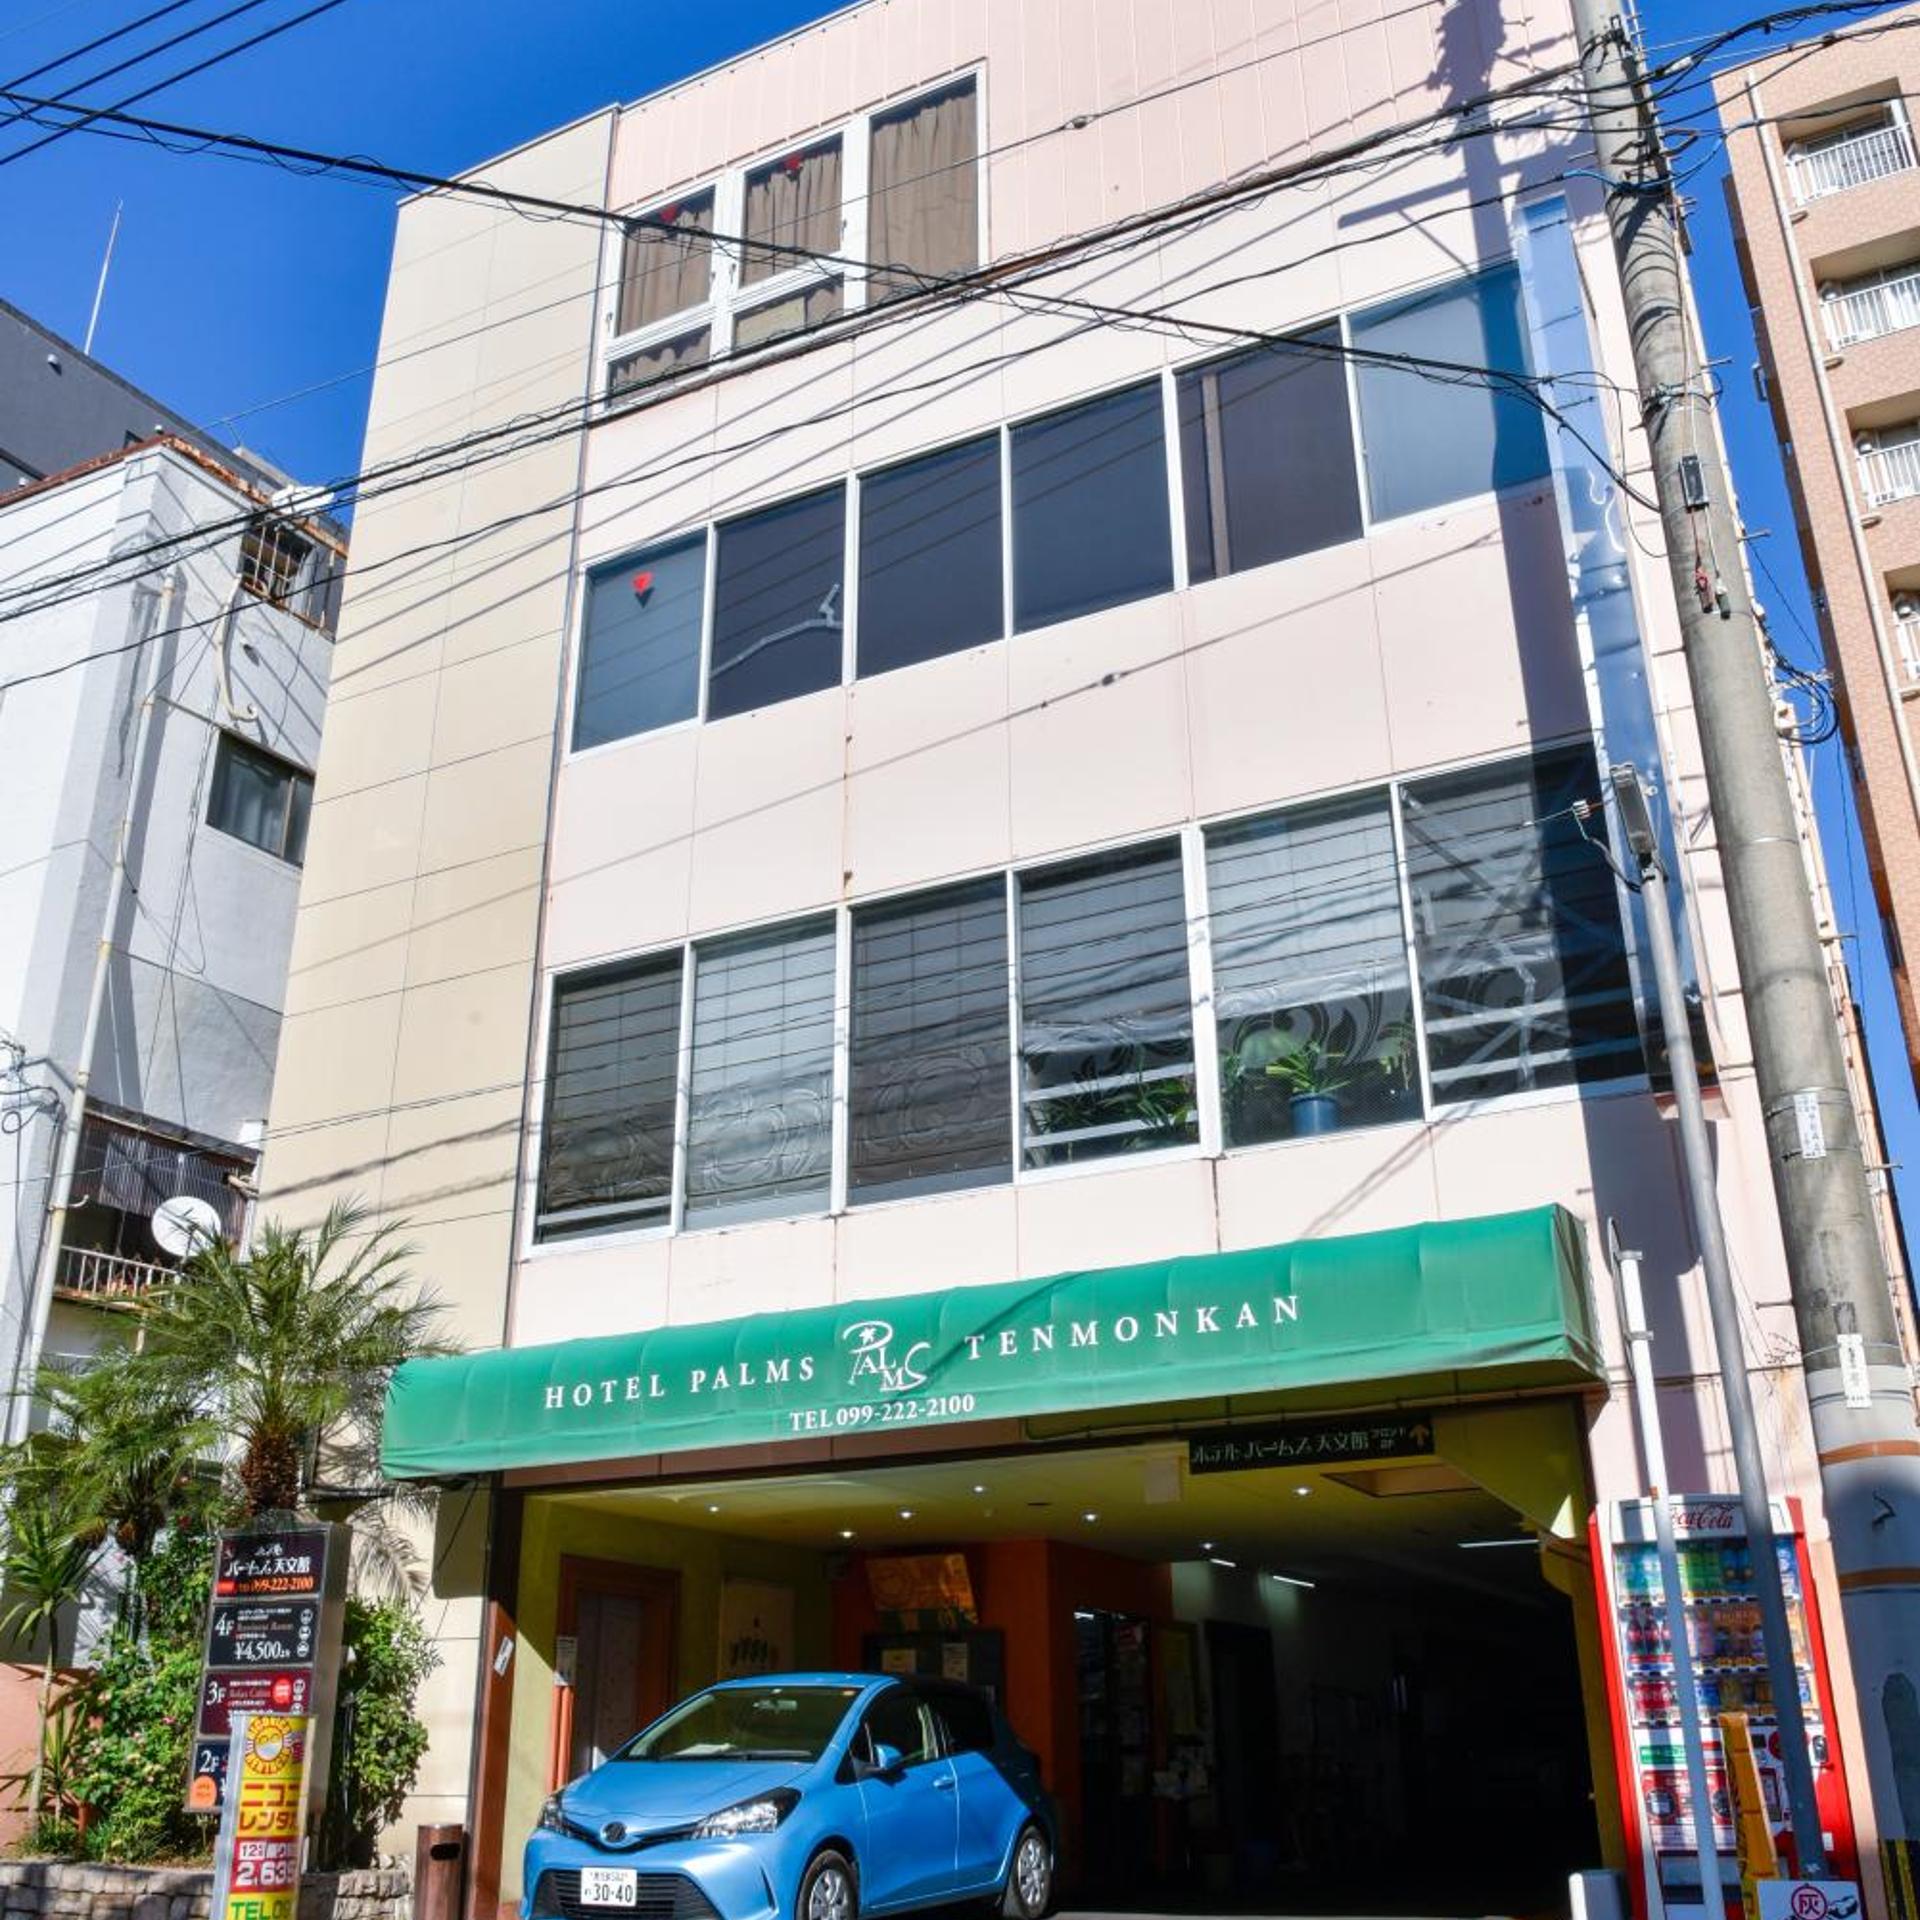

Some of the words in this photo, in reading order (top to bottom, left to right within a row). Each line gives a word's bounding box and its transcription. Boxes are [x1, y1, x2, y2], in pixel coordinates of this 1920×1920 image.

[964, 1295, 1300, 1361] TENMONKAN
[544, 1376, 666, 1408] HOTEL
[689, 1355, 817, 1393] PALMS
[215, 1612, 235, 1636] 4F
[234, 1641, 281, 1661] ¥4,500
[206, 1681, 227, 1706] 3F
[199, 1749, 220, 1773] 2F
[1799, 1894, 1820, 1915] 灰
